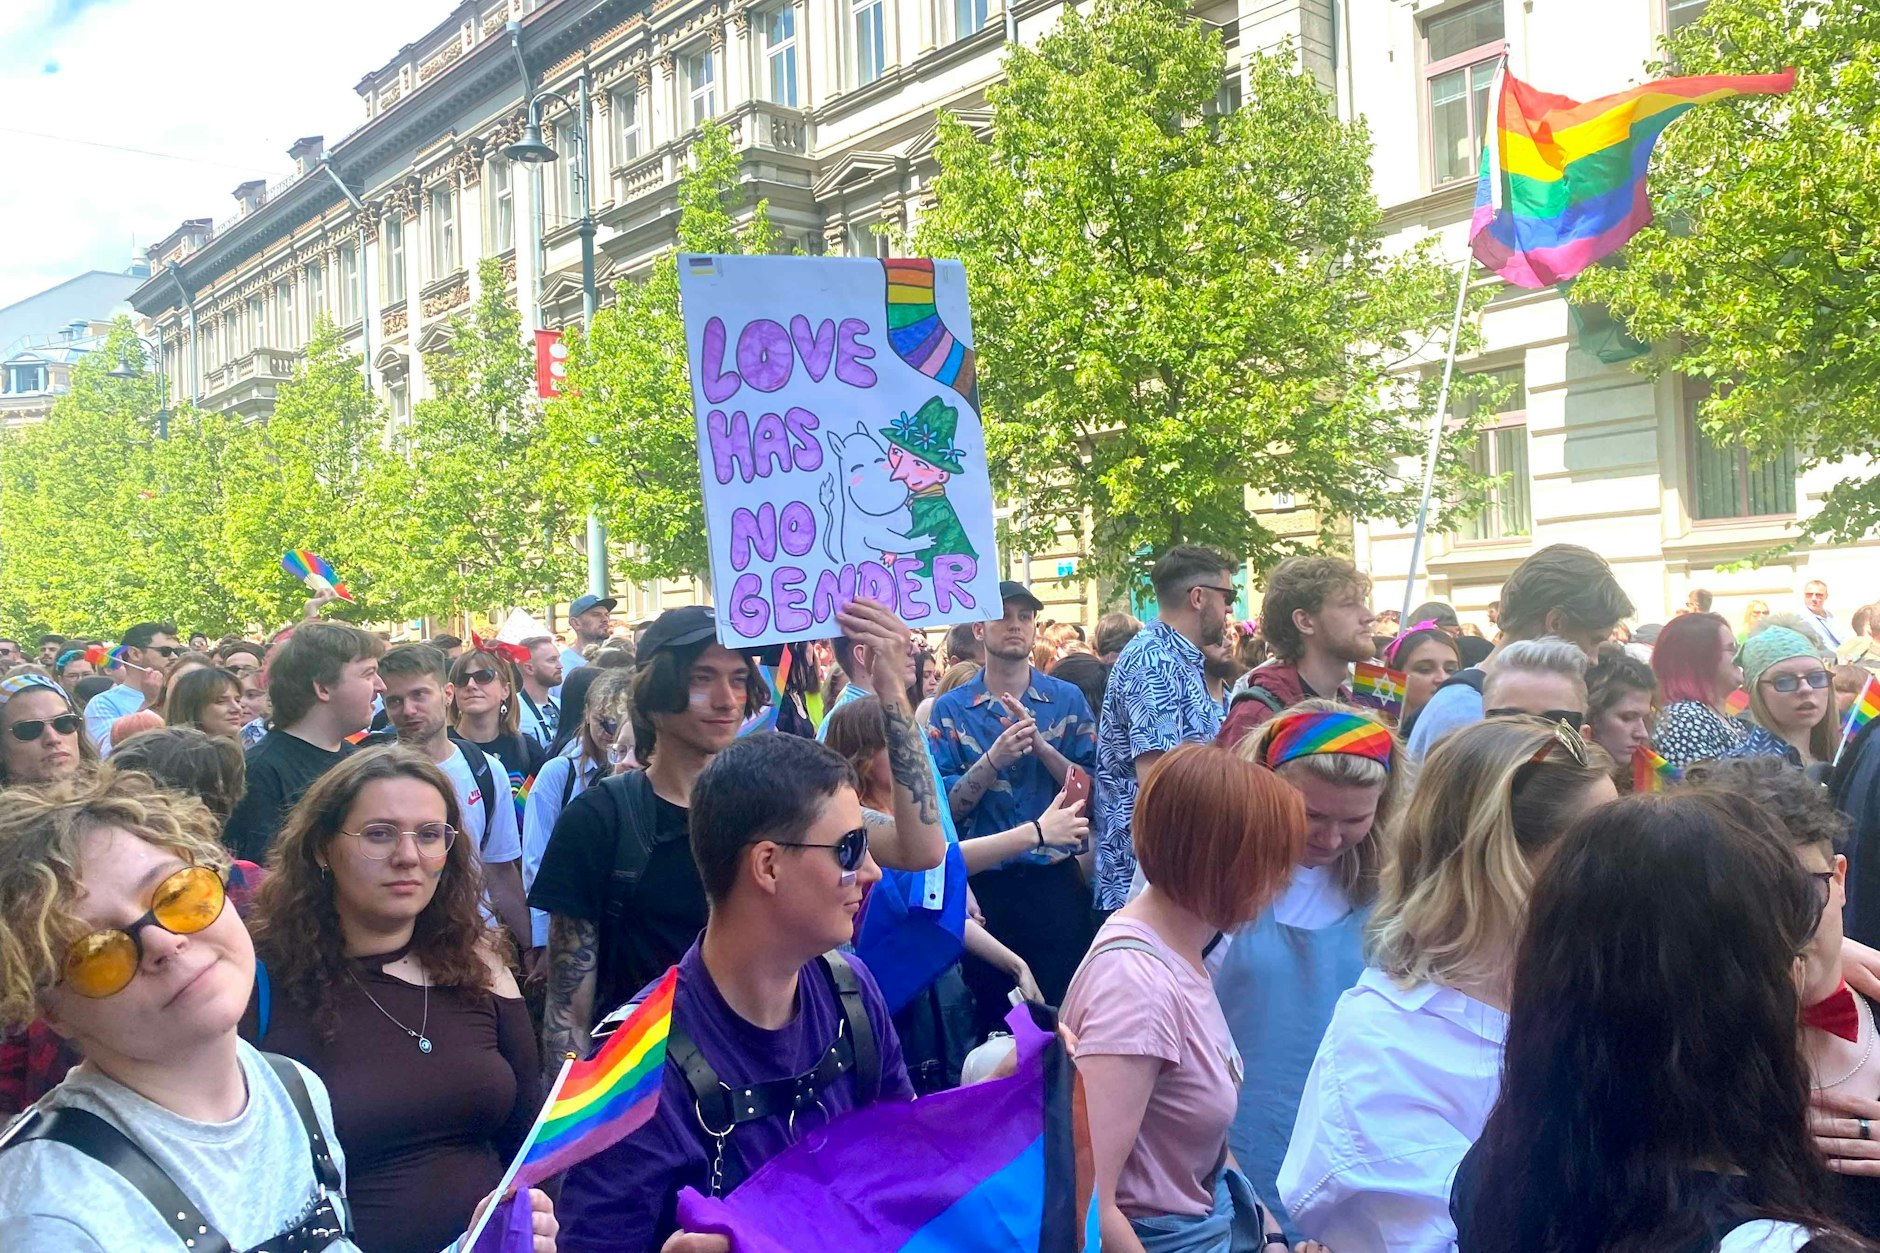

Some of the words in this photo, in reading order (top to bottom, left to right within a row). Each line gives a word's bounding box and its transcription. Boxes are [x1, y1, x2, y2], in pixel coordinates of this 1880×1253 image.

[701, 314, 878, 404] LOVE
[706, 407, 823, 485] HAS
[730, 501, 816, 572] NO
[729, 553, 977, 638] GENDER
